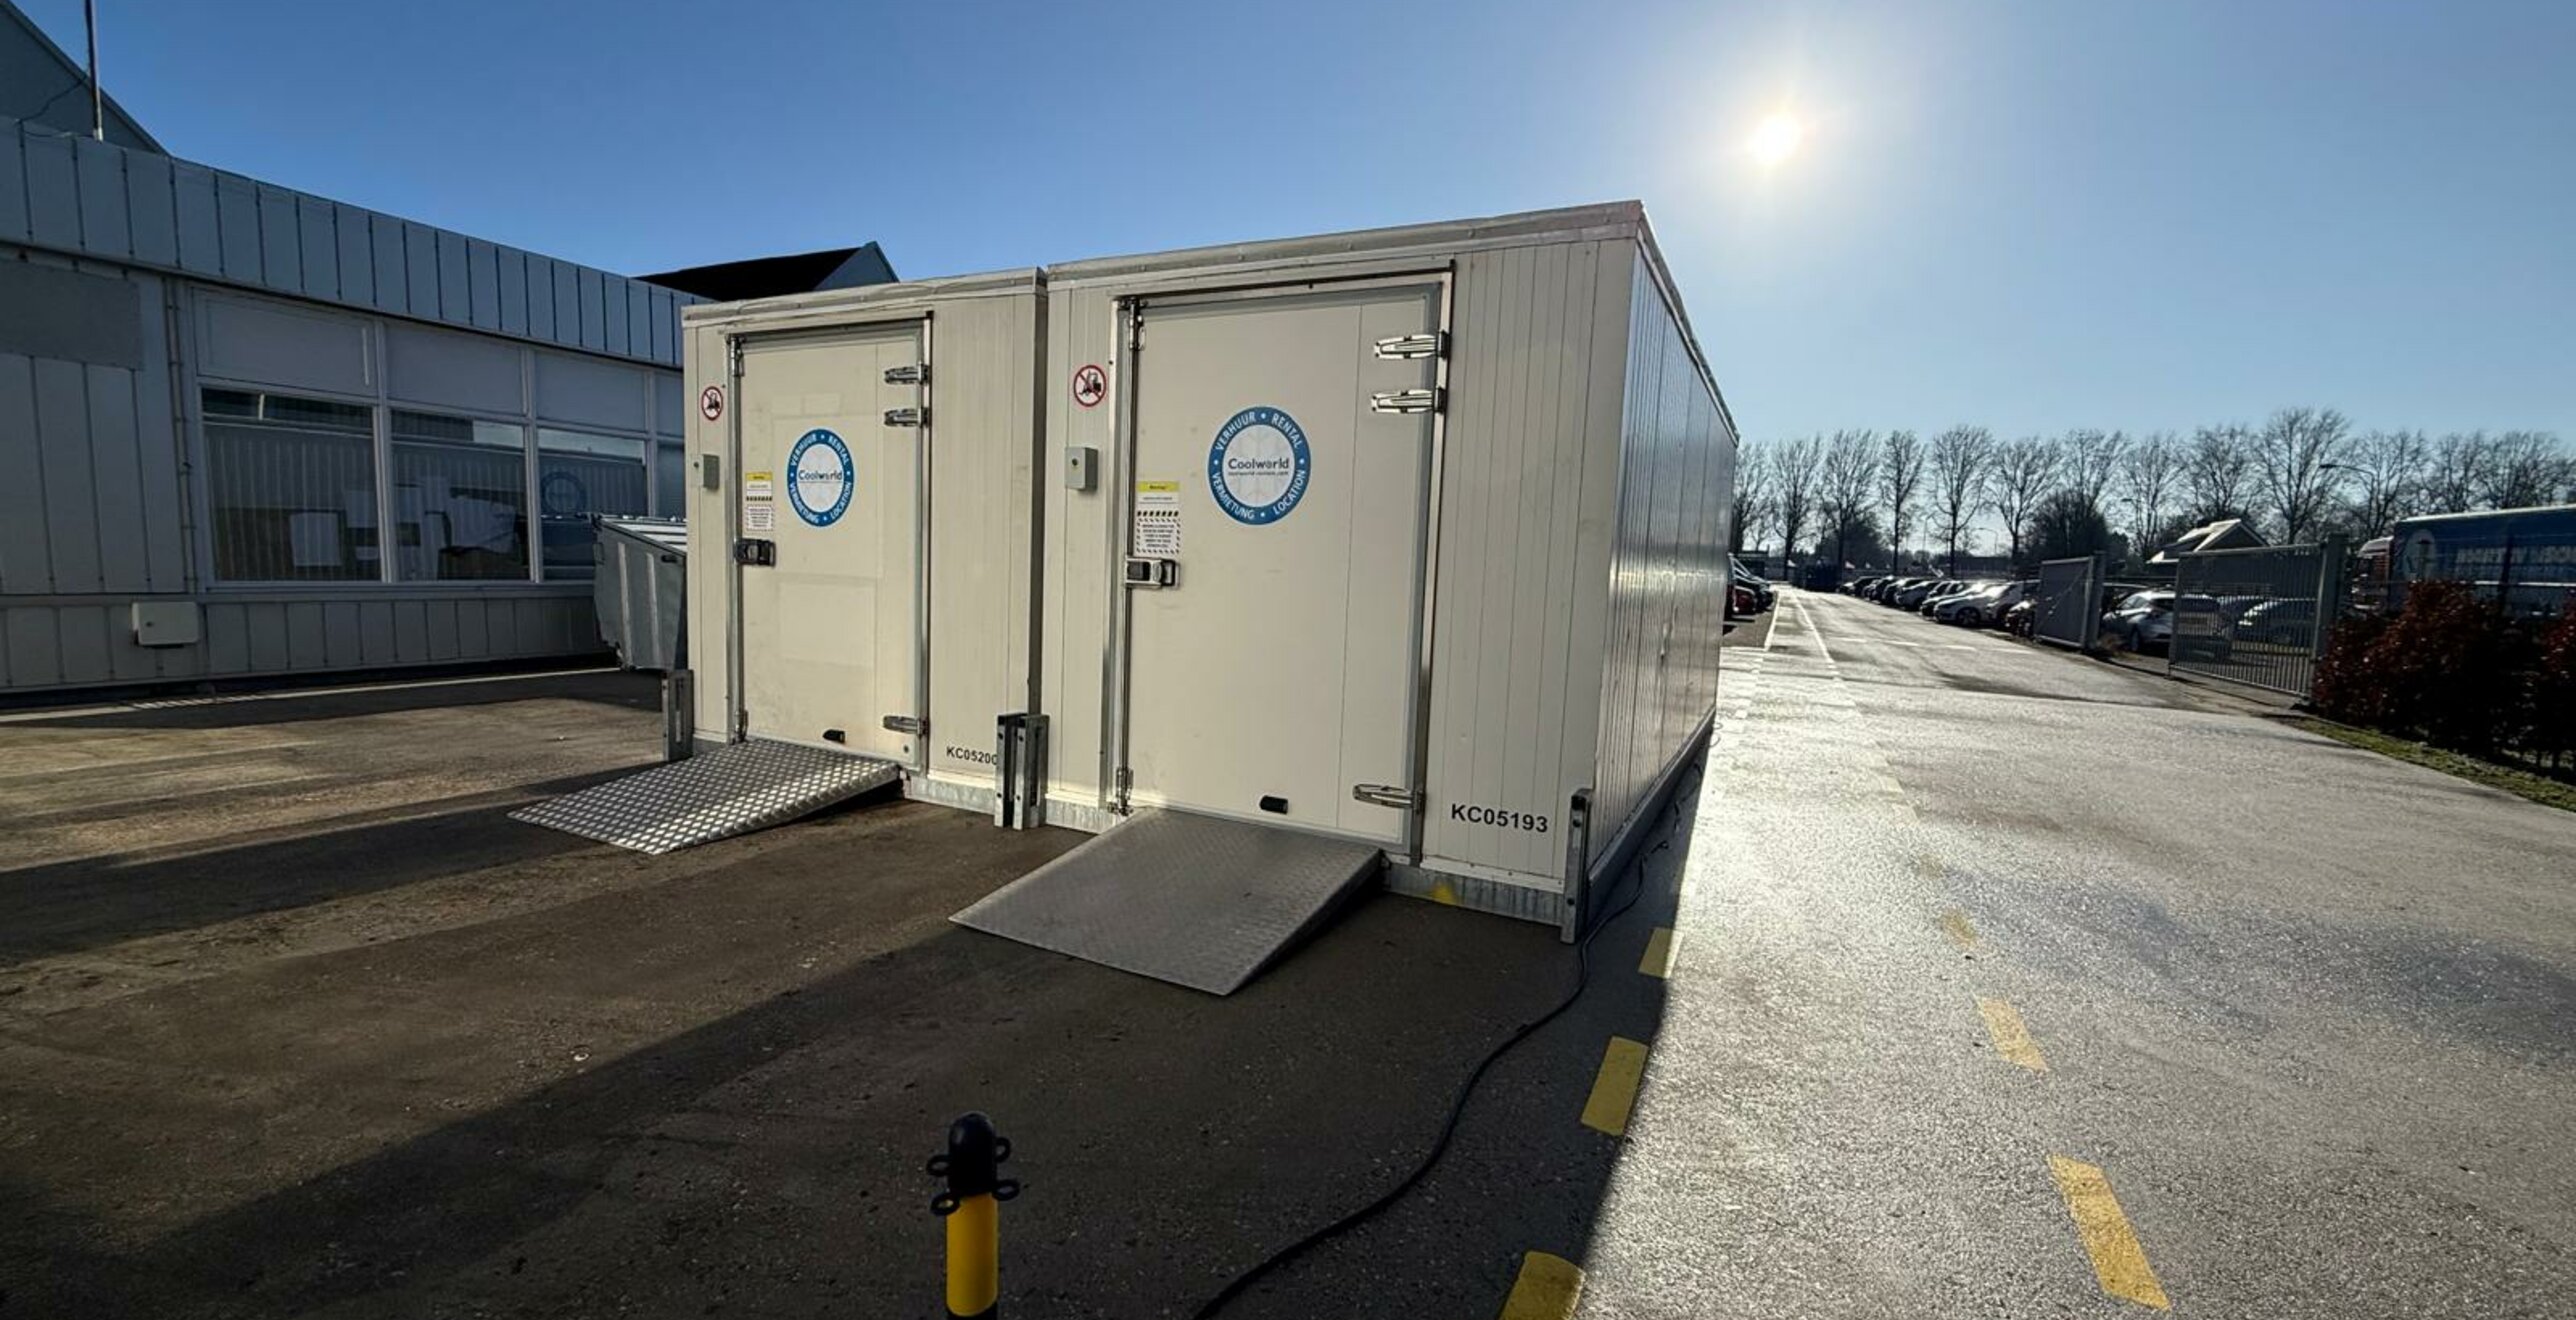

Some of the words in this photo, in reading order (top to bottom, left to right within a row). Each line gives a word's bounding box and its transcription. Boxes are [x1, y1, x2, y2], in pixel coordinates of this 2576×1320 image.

[1215, 411, 1256, 451] VERHUUR
[1271, 412, 1303, 449] RENTAL
[790, 433, 817, 467] VERHUUR
[828, 434, 850, 466] RENTAL
[1228, 457, 1290, 470] Coolworld
[798, 469, 843, 481] Coolworld
[1272, 469, 1306, 515] LOCATION
[789, 482, 820, 524] VERMIETUNG
[830, 481, 852, 520] LOCATION
[1211, 471, 1255, 520] VERMIETUNG
[1451, 803, 1548, 833] KC05193
